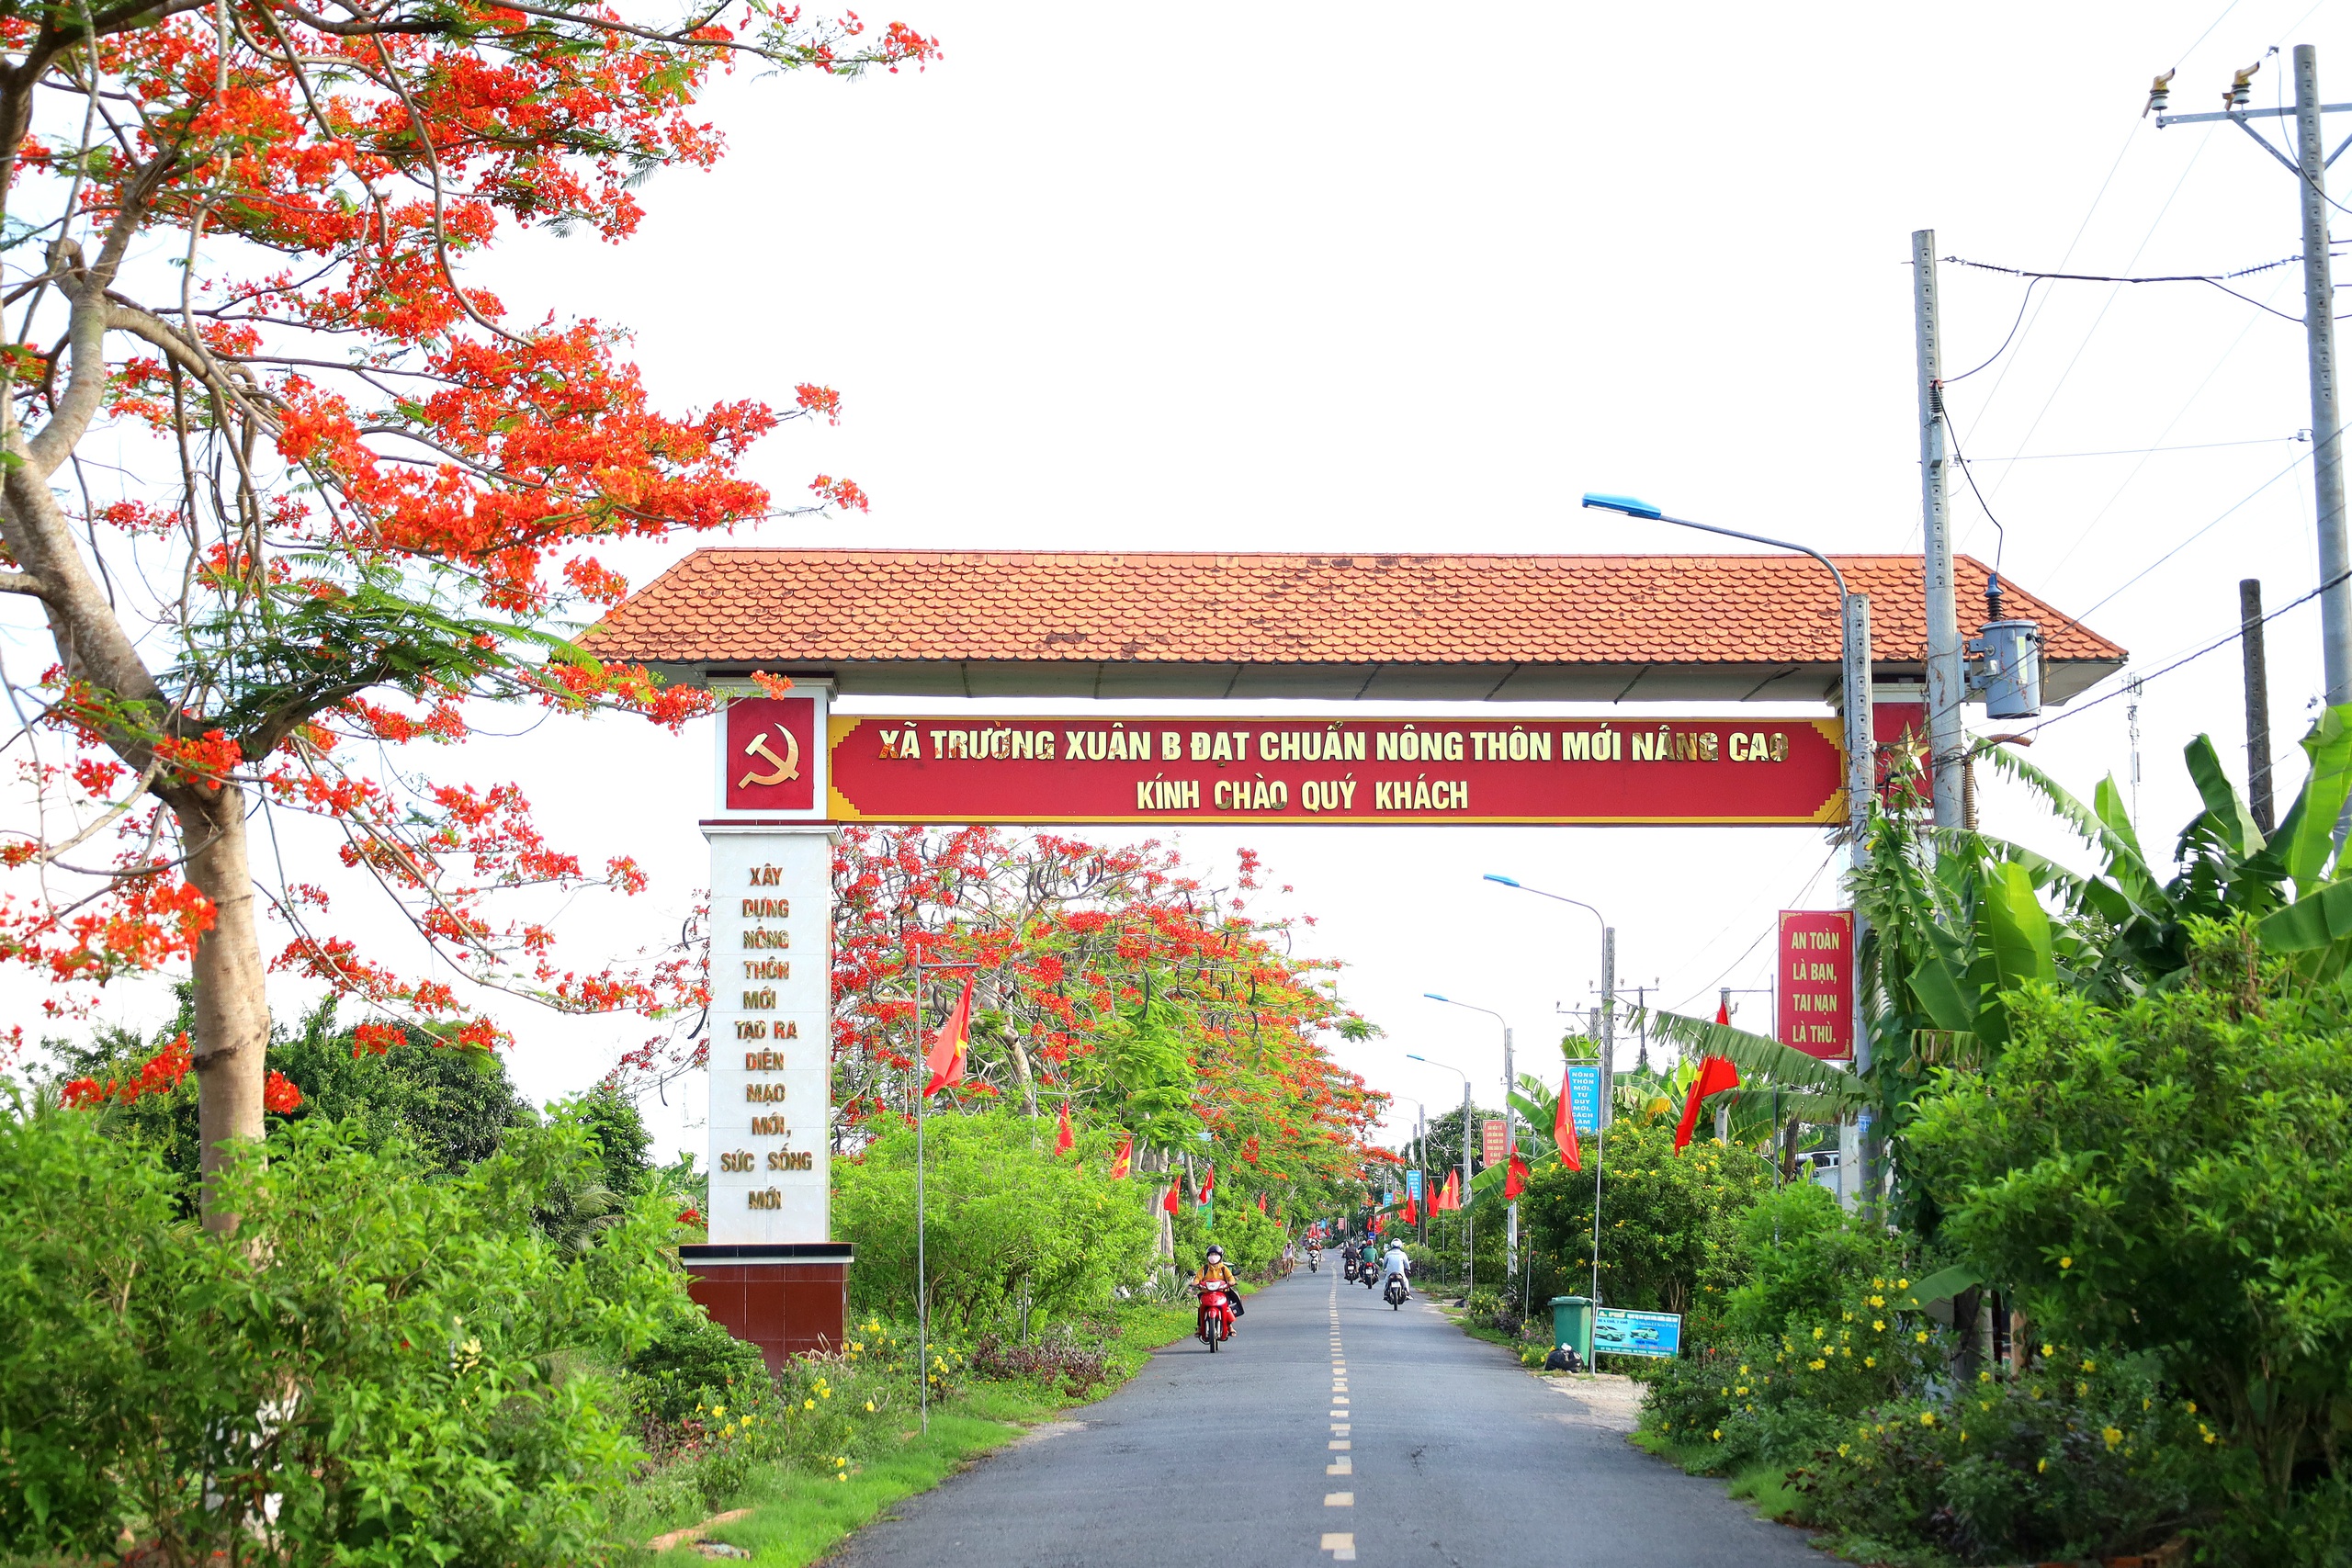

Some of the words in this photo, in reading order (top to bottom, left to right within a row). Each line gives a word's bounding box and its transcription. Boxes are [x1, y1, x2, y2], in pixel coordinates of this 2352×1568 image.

[878, 721, 921, 761] XÃ
[930, 721, 1055, 761] TRƯỜNG
[1065, 722, 1151, 761] XUÂN
[1162, 732, 1182, 761] B
[1190, 732, 1250, 767] ĐẠT
[1260, 720, 1366, 761] CHUẨN
[1376, 724, 1464, 761] NÔNG
[1470, 725, 1552, 761] THÔN
[1562, 723, 1622, 761] MỚI
[1632, 724, 1719, 761] NÂNG
[1728, 732, 1789, 762] CAO
[1136, 772, 1199, 810] KÍNH
[1214, 772, 1288, 810] CHÀO
[1301, 772, 1358, 814] QUÝ
[1374, 773, 1468, 810] KHÁCH
[750, 863, 783, 886] XÂY
[742, 897, 789, 922] DỰNG
[743, 925, 789, 949] NÔNG
[1791, 931, 1806, 950] AN
[1809, 928, 1839, 950] TOÀN
[743, 955, 789, 980] THÔN
[1792, 959, 1807, 981] LÀ
[1811, 963, 1837, 985] BẠN,
[743, 985, 776, 1010] MỚI
[1792, 994, 1811, 1012] TAI
[1814, 994, 1837, 1015] NẠN
[735, 1020, 766, 1043] TẠO
[774, 1020, 798, 1040] RA
[1792, 1021, 1807, 1043] LÀ
[1809, 1021, 1837, 1043] THÙ.
[745, 1046, 785, 1074] DIỆN
[746, 1083, 786, 1106] MẠO
[752, 1111, 792, 1138] MỚI,
[720, 1148, 755, 1172] SỨC
[767, 1142, 813, 1171] SỐNG
[748, 1186, 782, 1210] MỚI
